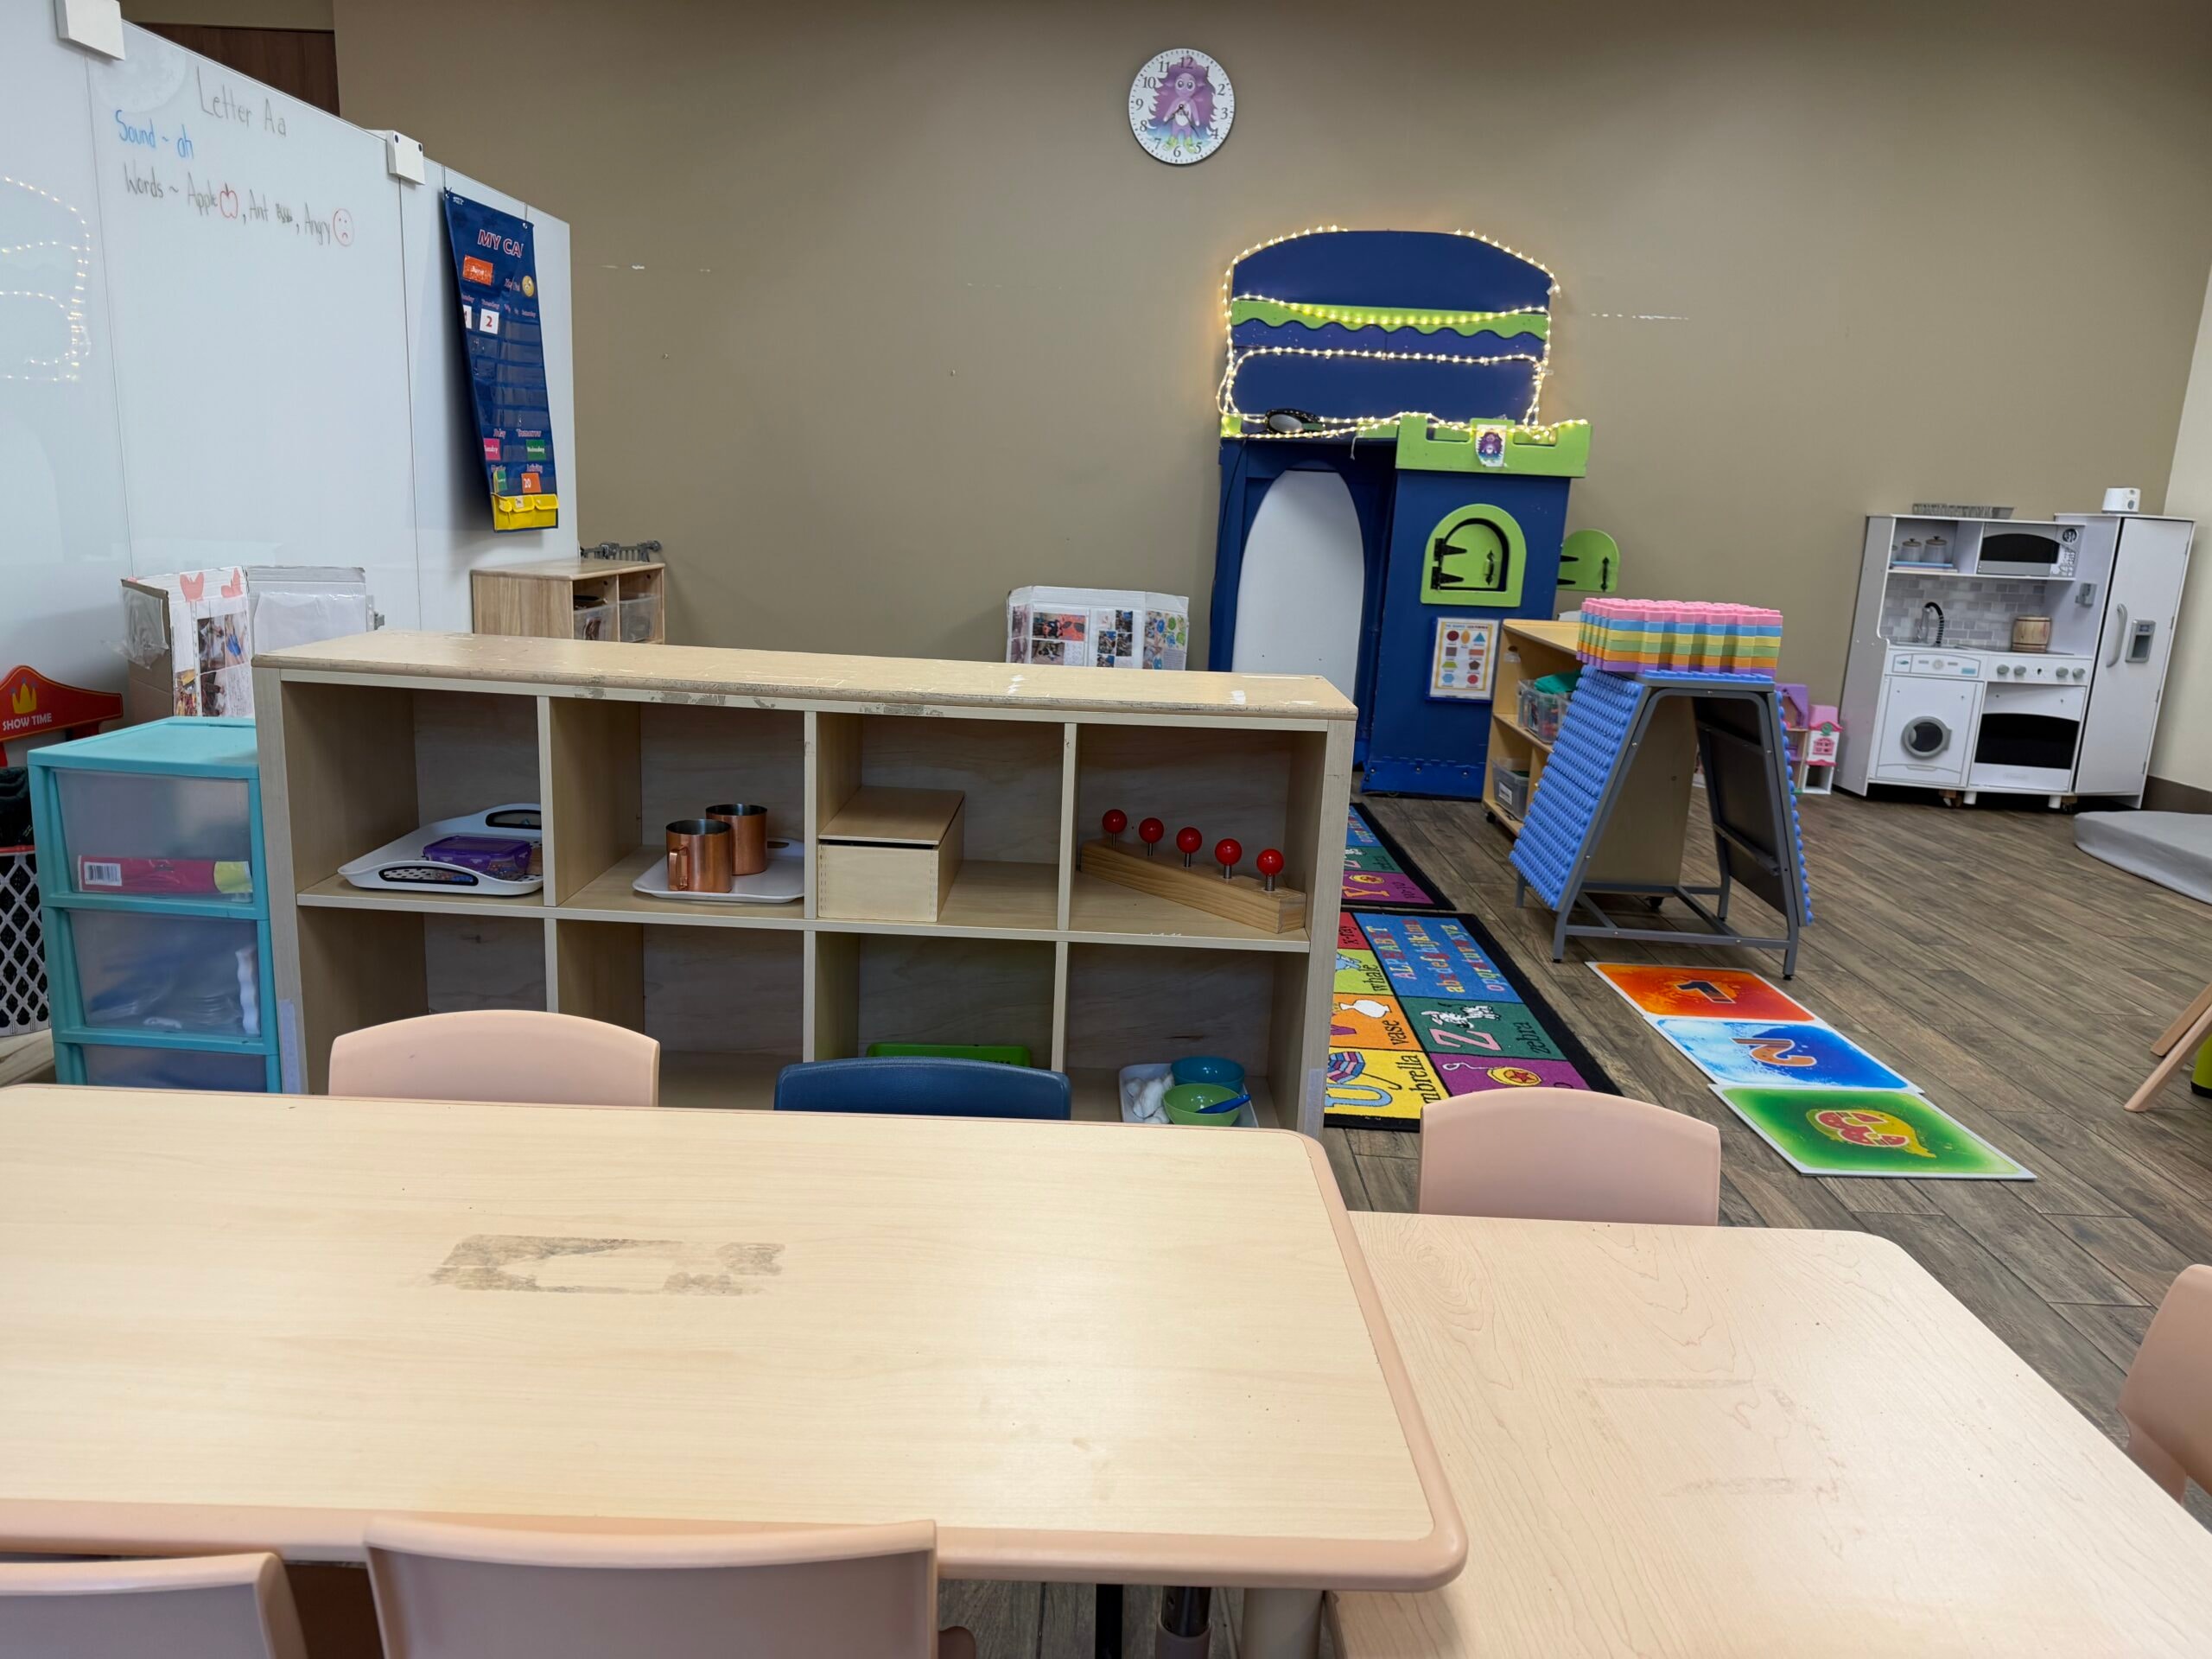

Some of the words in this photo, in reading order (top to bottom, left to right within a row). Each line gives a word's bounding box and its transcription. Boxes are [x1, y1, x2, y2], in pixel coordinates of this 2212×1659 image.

[1159, 61, 1170, 73] 11
[1180, 56, 1193, 69] 12
[1142, 76, 1156, 89] 10
[1217, 84, 1225, 96] 2
[196, 66, 252, 128] Letter
[264, 98, 286, 137] Aa
[1136, 99, 1143, 111] 9
[1220, 107, 1228, 119] 3
[115, 109, 156, 148] Sound
[1140, 120, 1147, 131] 8
[1210, 128, 1218, 139] 4
[1154, 138, 1161, 149] 7
[1173, 145, 1181, 157] 6
[1194, 142, 1202, 154] 5
[124, 160, 163, 198] Words
[188, 172, 218, 216] Apple
[249, 189, 269, 222] Ant
[305, 202, 331, 245] Angry
[477, 229, 501, 251] MY
[486, 315, 493, 327] 2
[3, 716, 29, 731] SHOW
[31, 713, 53, 725] TIME
[1359, 964, 1389, 992] whale
[1676, 981, 1735, 1004] 1
[1382, 1020, 1409, 1045] vase
[1428, 1028, 1503, 1051] Z
[1513, 1021, 1551, 1054] zebra
[1728, 1037, 1817, 1067] 2
[1395, 1054, 1440, 1104] mbrella
[1815, 1109, 1910, 1147] 3
